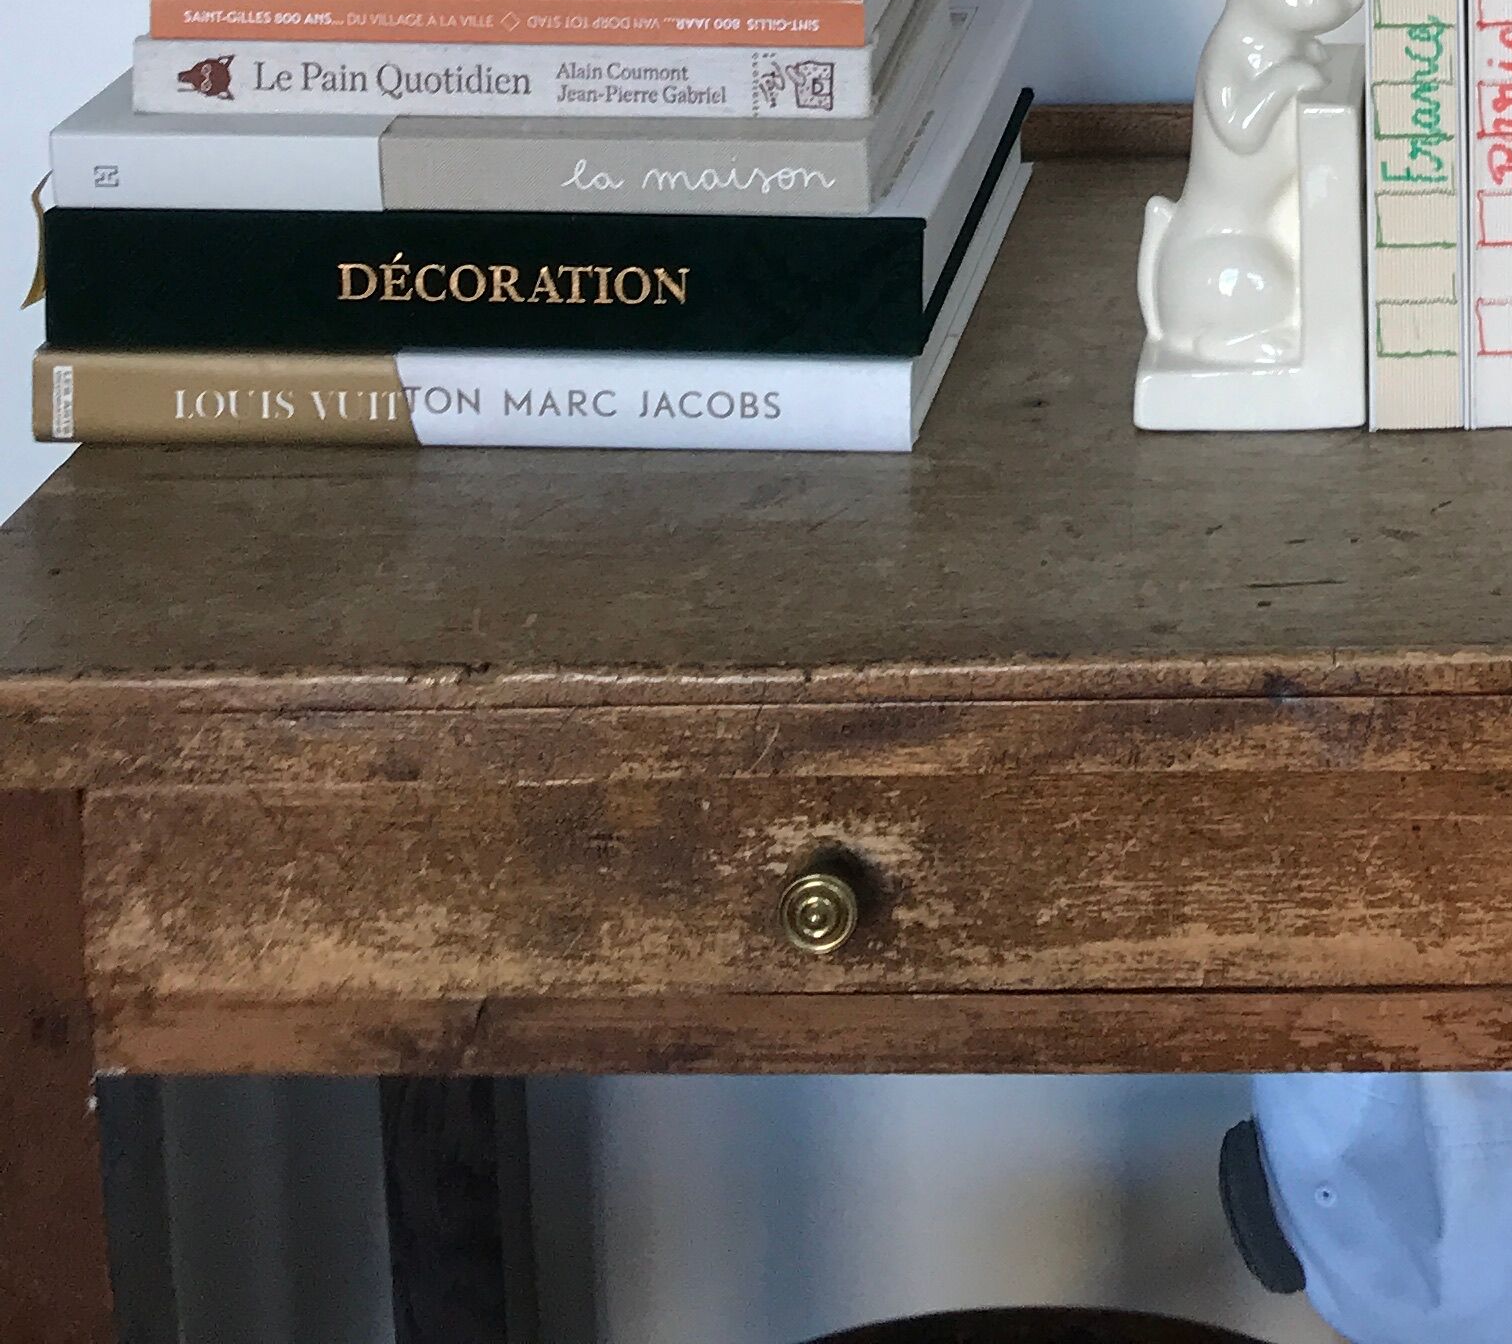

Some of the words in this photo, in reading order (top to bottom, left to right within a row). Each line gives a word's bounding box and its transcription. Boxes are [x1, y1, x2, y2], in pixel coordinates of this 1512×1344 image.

[184, 10, 272, 25] SAINT-GILLES
[274, 12, 301, 25] 800
[346, 13, 367, 26] DU
[369, 14, 423, 27] VILLAGE
[439, 15, 459, 28] LA
[460, 16, 494, 28] VILLE
[592, 16, 630, 29] DORP
[632, 16, 660, 29] VAN
[713, 18, 741, 31] 800
[253, 62, 293, 92] Le
[301, 61, 369, 92] Pain
[376, 62, 532, 100] Quotidien
[556, 62, 602, 81] Alain
[606, 63, 689, 81] Coumont
[556, 84, 659, 104] Jean-Pierre
[662, 86, 727, 105] Gabriel
[1380, 15, 1449, 183] France
[561, 158, 624, 191] la
[641, 158, 837, 195] maison
[337, 251, 691, 306] DÉCORATION
[174, 388, 296, 421] LOUIS
[309, 385, 481, 422] VUITTON
[503, 389, 617, 419] MARC
[639, 390, 782, 422] JACOBS
